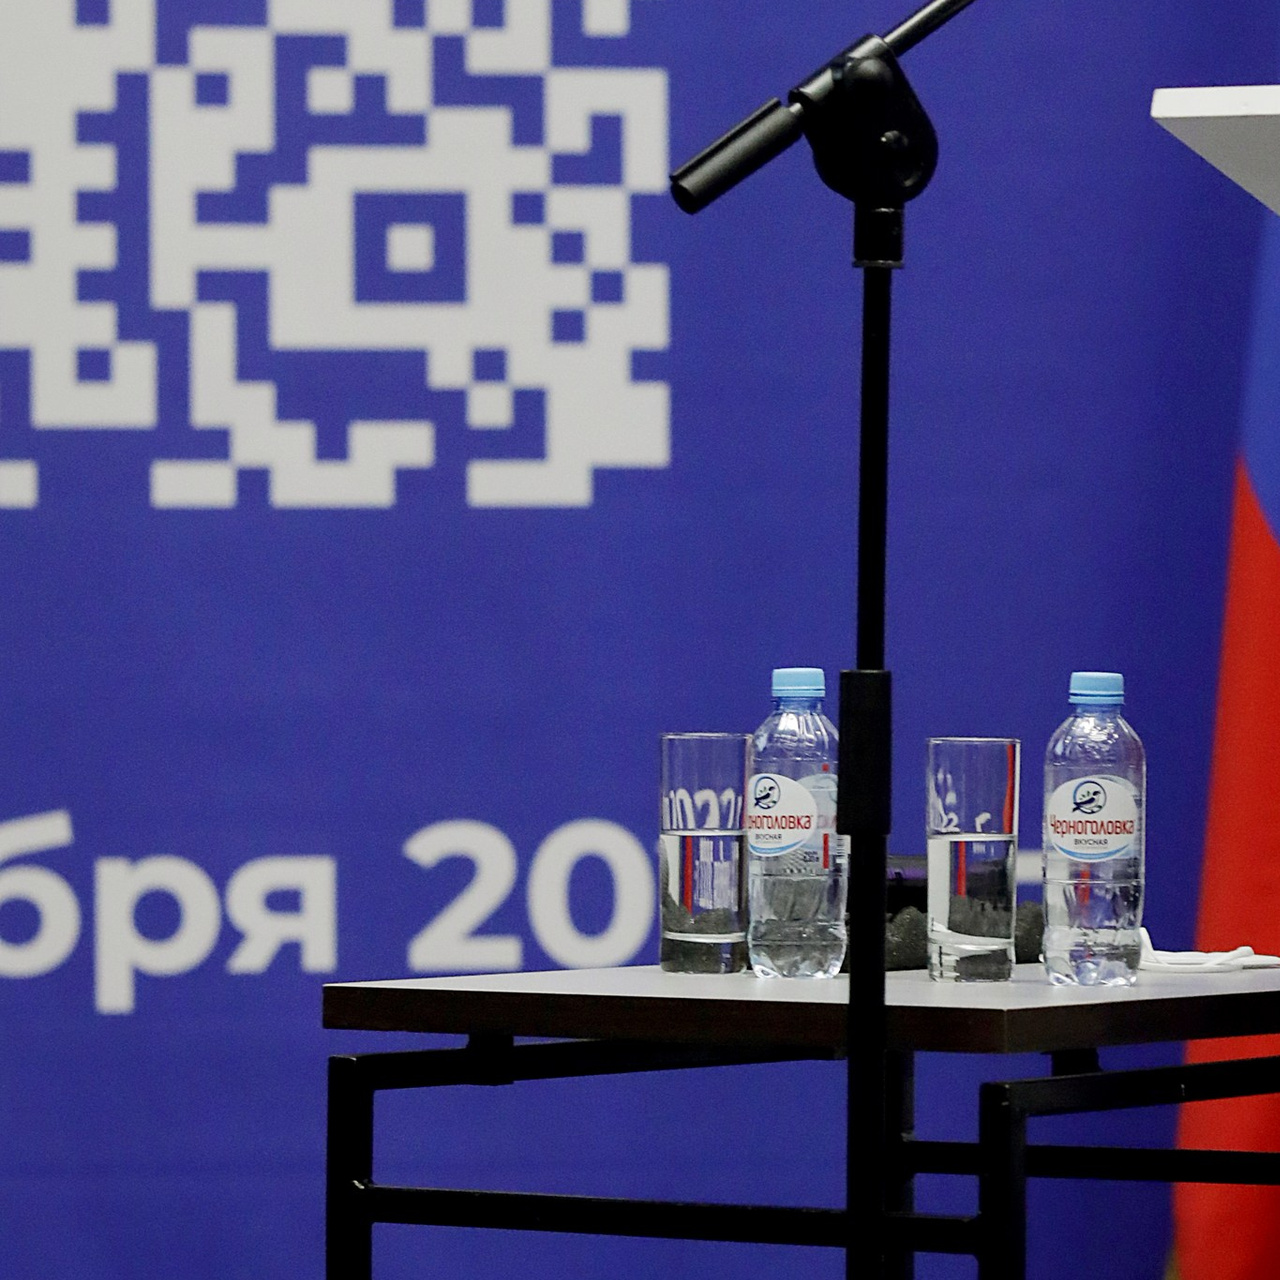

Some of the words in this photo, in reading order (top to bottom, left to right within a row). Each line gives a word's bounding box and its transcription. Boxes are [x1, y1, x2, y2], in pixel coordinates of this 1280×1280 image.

[748, 814, 812, 830] ноголовка
[1074, 838, 1109, 846] ВКУСНАЯ
[403, 819, 657, 970] 20
